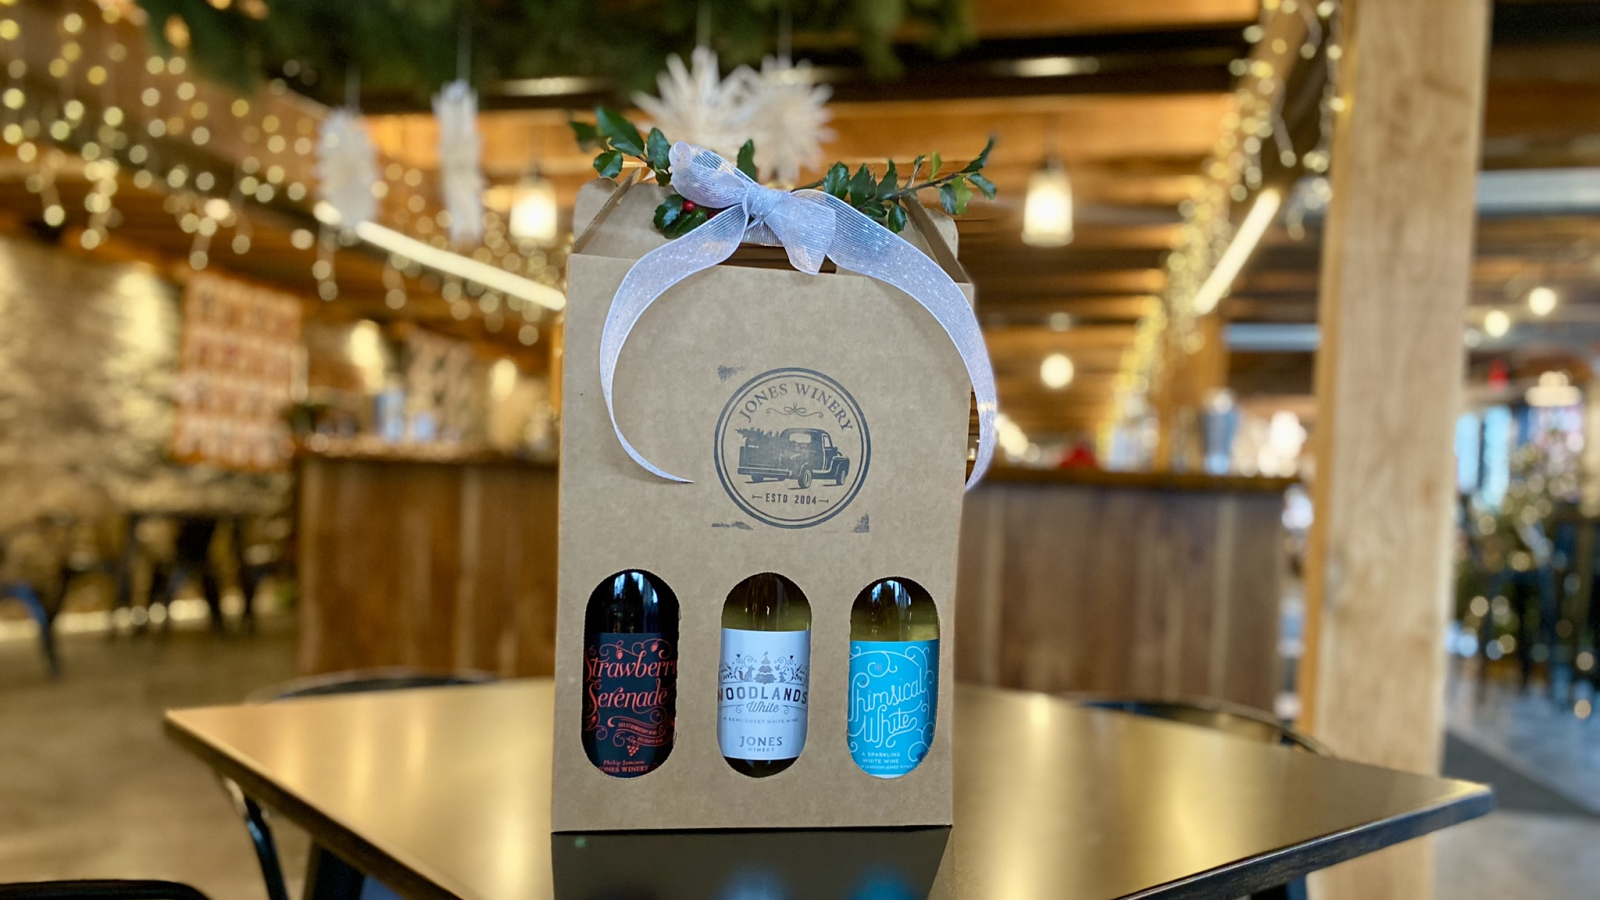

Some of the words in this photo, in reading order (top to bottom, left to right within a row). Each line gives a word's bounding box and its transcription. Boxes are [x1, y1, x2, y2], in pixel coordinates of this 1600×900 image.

[739, 383, 788, 423] JONES
[795, 383, 853, 431] WINERY
[765, 493, 788, 503] ESTD
[794, 494, 817, 505] 2004
[587, 679, 668, 717] Serenade
[746, 701, 780, 713] White
[856, 704, 919, 748] White
[739, 735, 783, 747] JONES
[621, 765, 649, 773] WINERY
